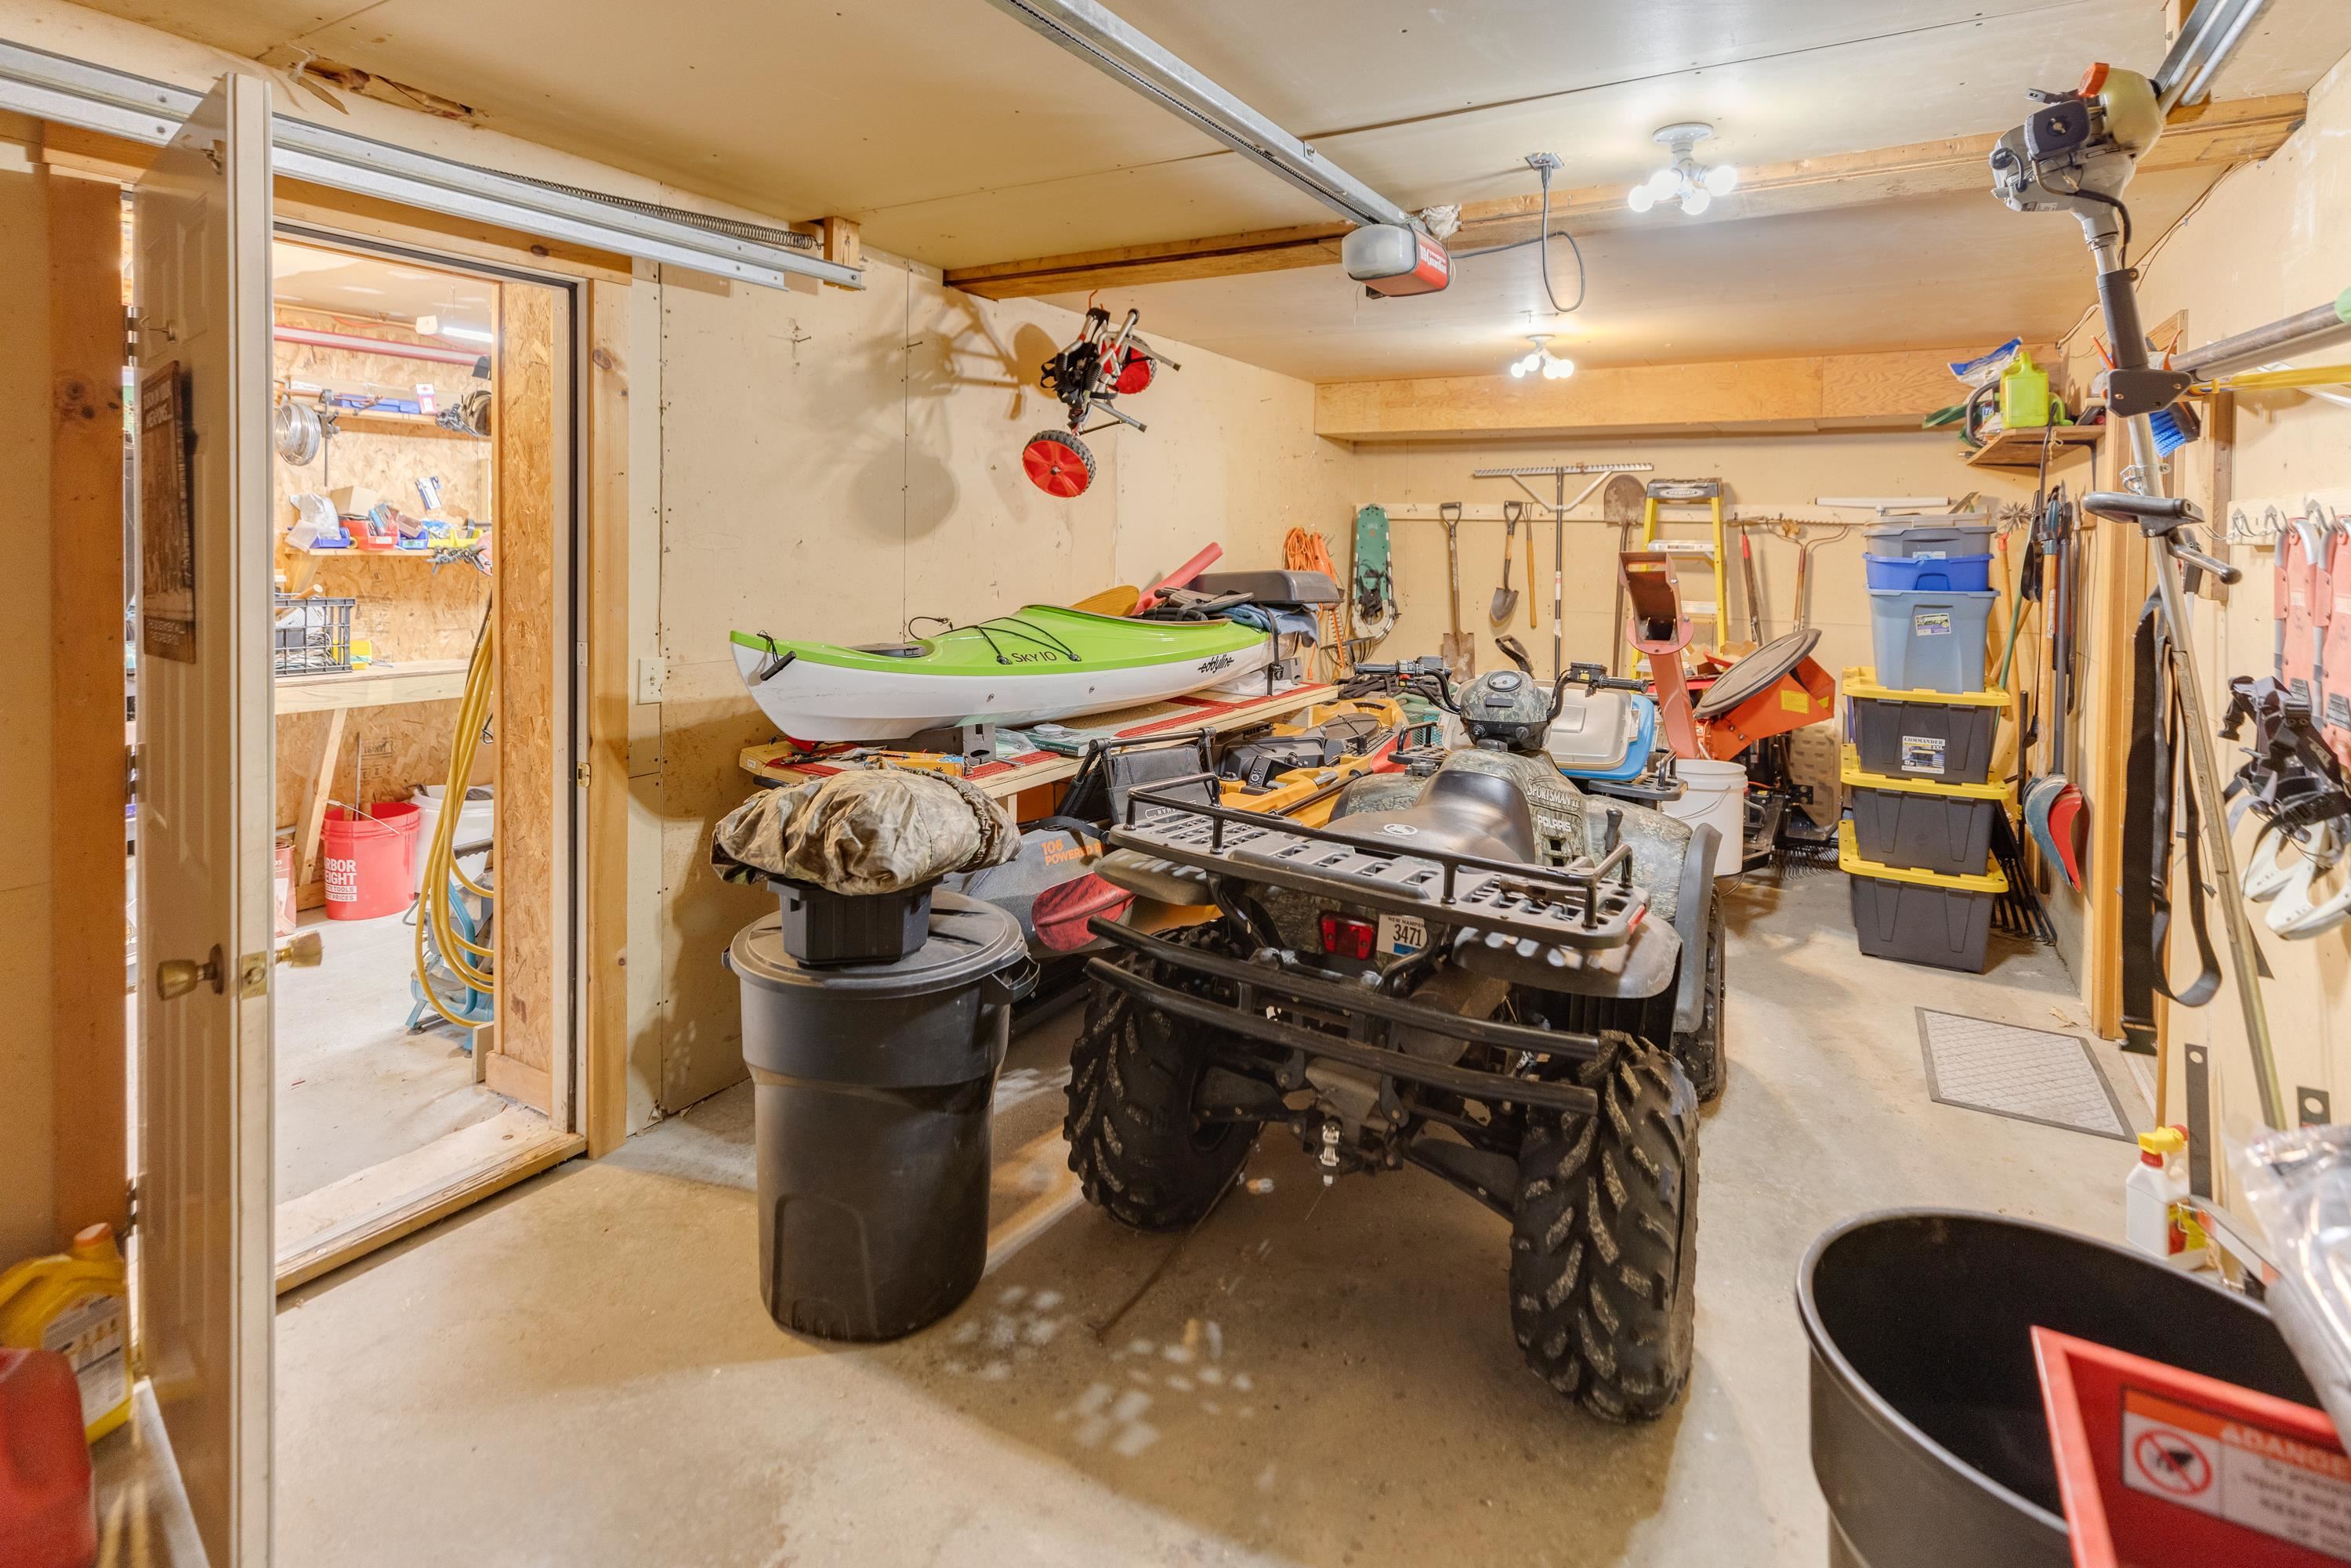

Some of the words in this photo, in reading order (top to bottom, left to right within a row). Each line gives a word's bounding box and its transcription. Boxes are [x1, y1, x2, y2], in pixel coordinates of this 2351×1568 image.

[1904, 737, 1944, 745] COMMANDER
[1527, 779, 1570, 806] SPORTSMAN
[1537, 814, 1572, 832] POLARIS
[325, 856, 357, 873] RBOR
[325, 870, 357, 885] EIGHT
[1393, 923, 1422, 947] 3471
